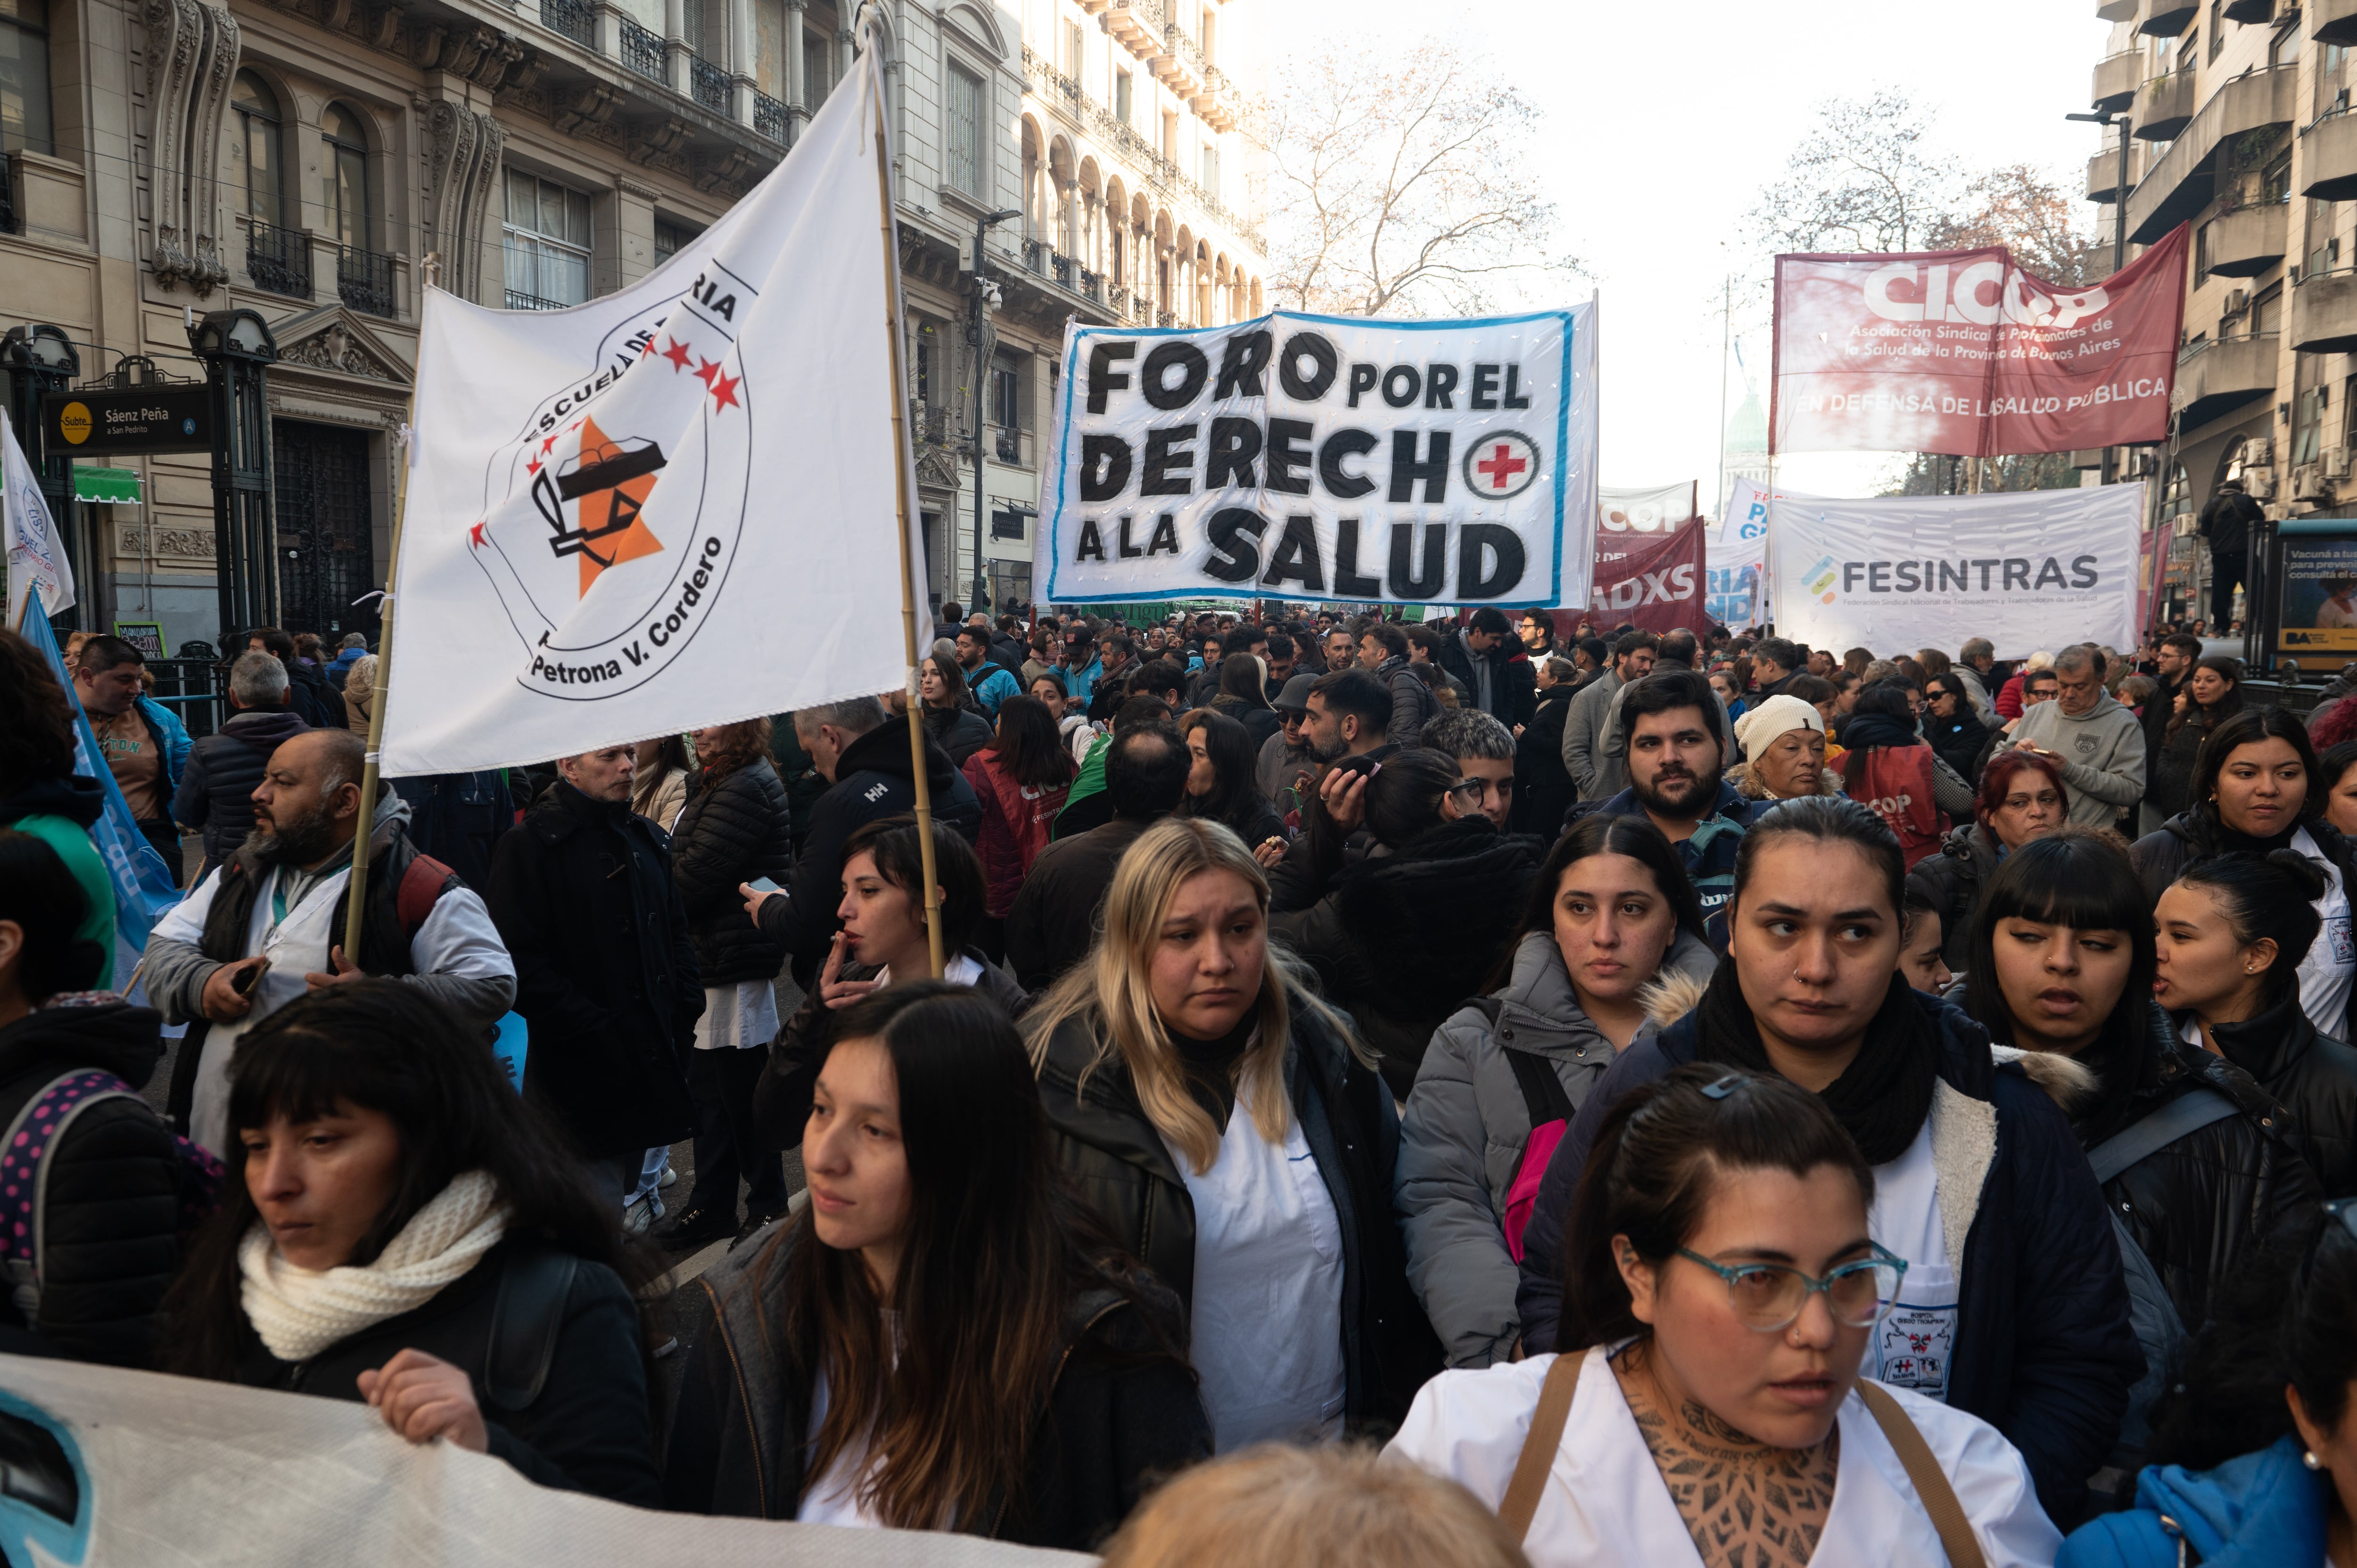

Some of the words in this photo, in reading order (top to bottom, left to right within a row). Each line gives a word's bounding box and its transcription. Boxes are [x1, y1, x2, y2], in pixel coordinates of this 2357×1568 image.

[1849, 324, 1931, 338] Asociación
[1936, 325, 1991, 341] Sindical
[2092, 318, 2114, 333] de
[1864, 343, 1907, 356] Salud
[1912, 344, 1930, 357] de
[1936, 344, 1950, 358] la
[2078, 337, 2121, 357] Aires
[1086, 329, 1339, 415] FORO
[1347, 362, 1459, 409] POR
[1469, 363, 1530, 410] EL
[523, 353, 635, 443] ESCUELA
[1830, 394, 1936, 413] DEFENSA
[1942, 397, 1970, 416] DE
[65, 416, 87, 426] Subte
[106, 409, 138, 423] Sáenz
[141, 407, 169, 420] Peña
[186, 421, 193, 431] A
[1597, 499, 1689, 532] COP
[19, 529, 38, 553] GUEL
[1077, 519, 1105, 560] A
[1119, 514, 1178, 557] LA
[1203, 508, 1526, 599] SALUD
[2291, 549, 2331, 558] Vacuná
[1844, 555, 2099, 593] FESINTRAS
[2289, 570, 2336, 579] consultá
[2338, 570, 2348, 578] el
[2291, 561, 2314, 569] para
[531, 655, 622, 684] Petrona
[622, 640, 650, 666] V.
[648, 536, 721, 647] Cordero
[1954, 597, 1999, 606] Trabajadores
[120, 627, 157, 637] MANDARINA
[140, 651, 162, 659] NACA
[864, 783, 889, 802] HH
[1037, 806, 1064, 821] FESINTRA
[1863, 794, 1912, 816] COP
